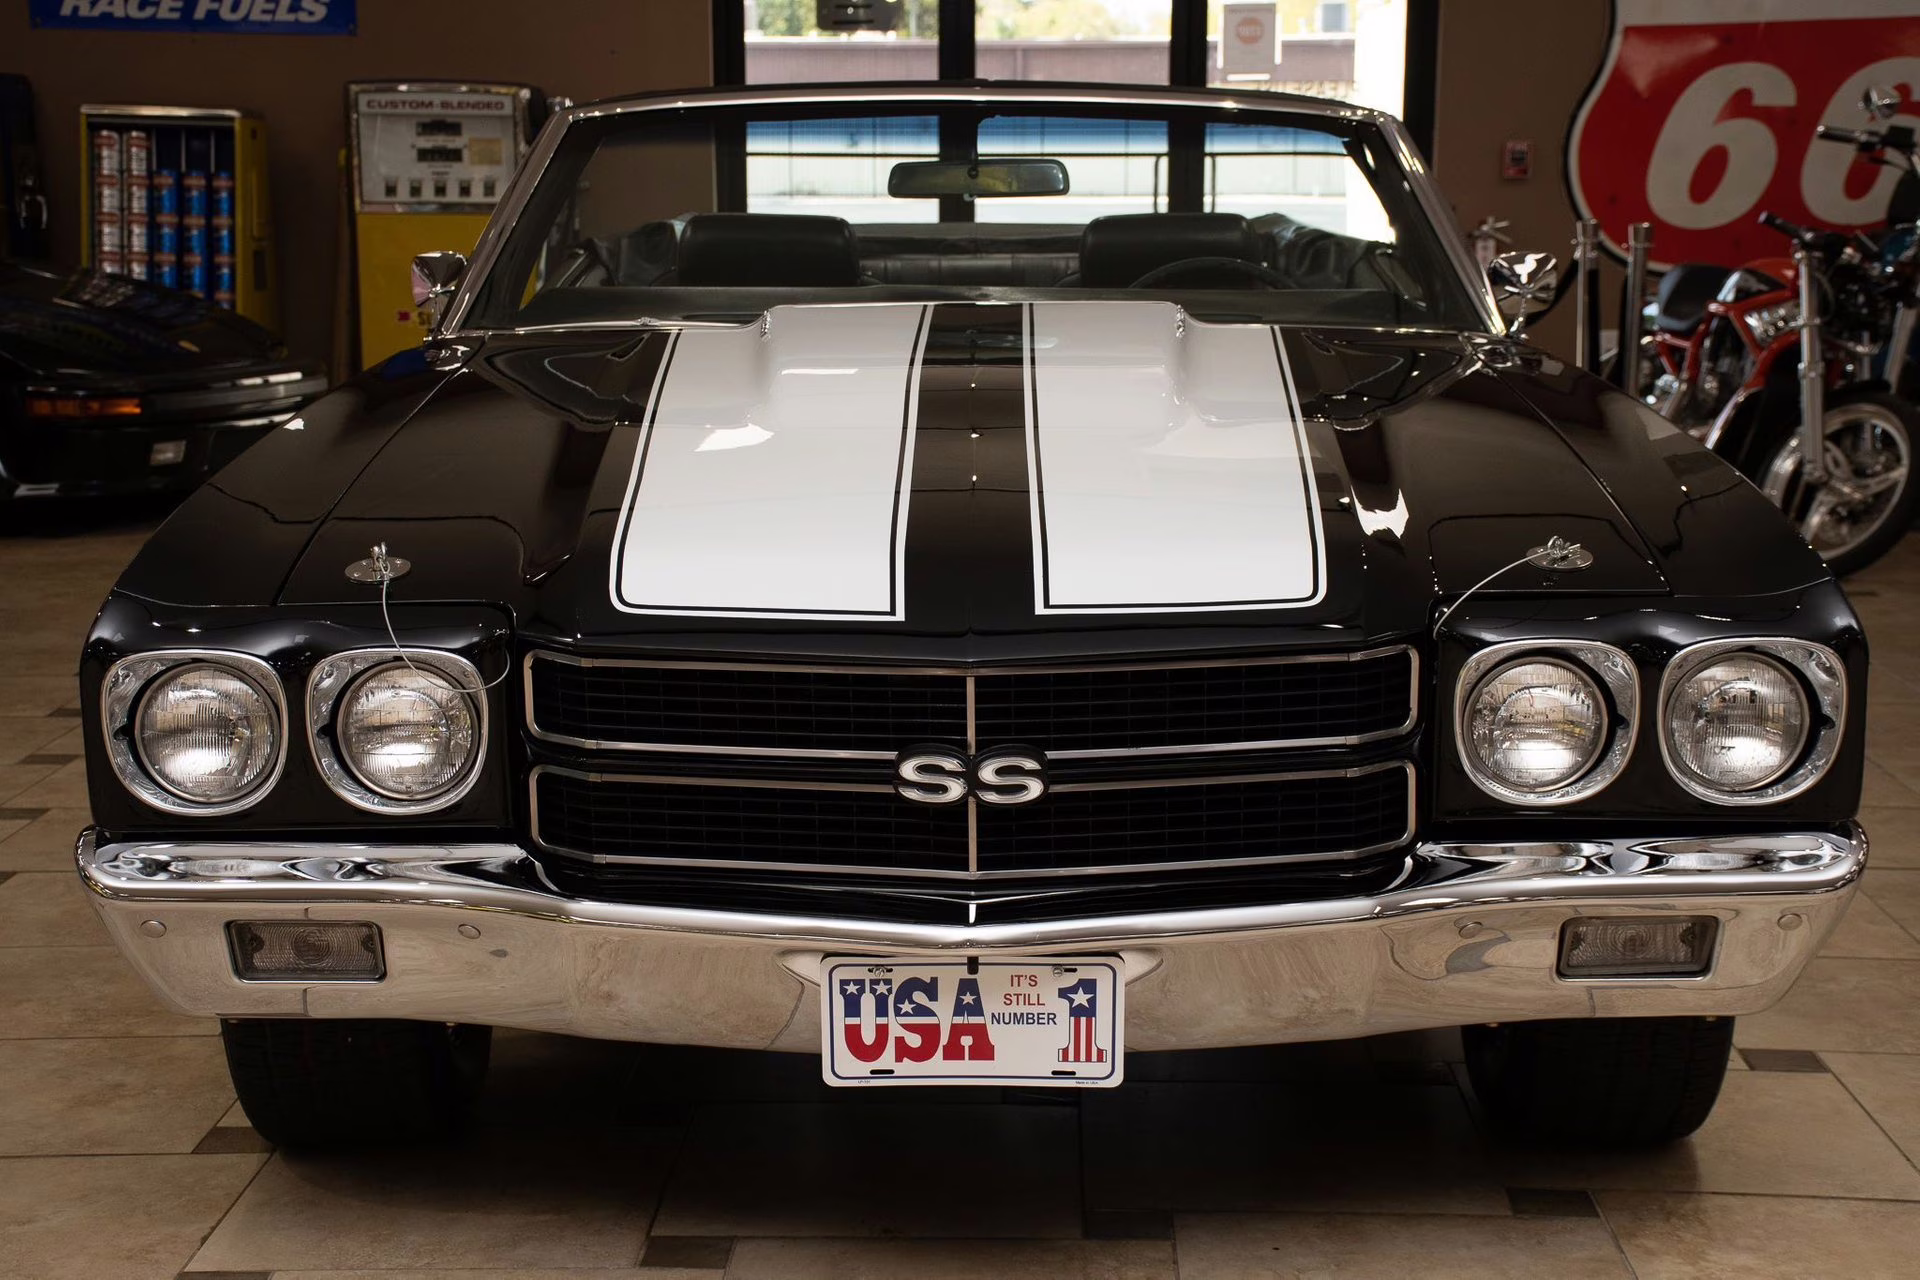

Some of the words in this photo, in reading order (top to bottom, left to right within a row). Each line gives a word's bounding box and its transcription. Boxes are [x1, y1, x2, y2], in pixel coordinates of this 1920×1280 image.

[59, 0, 187, 20] RACE
[193, 0, 329, 23] FUELS
[366, 99, 433, 110] CUSTOM
[440, 100, 505, 111] BLENDED
[1645, 55, 1920, 230] 66
[897, 755, 1045, 804] SS
[1010, 974, 1038, 988] IT'S
[1003, 993, 1046, 1006] STILL
[839, 976, 995, 1063] USA
[991, 1012, 1057, 1026] NUMBER
[1058, 978, 1107, 1063] 1
